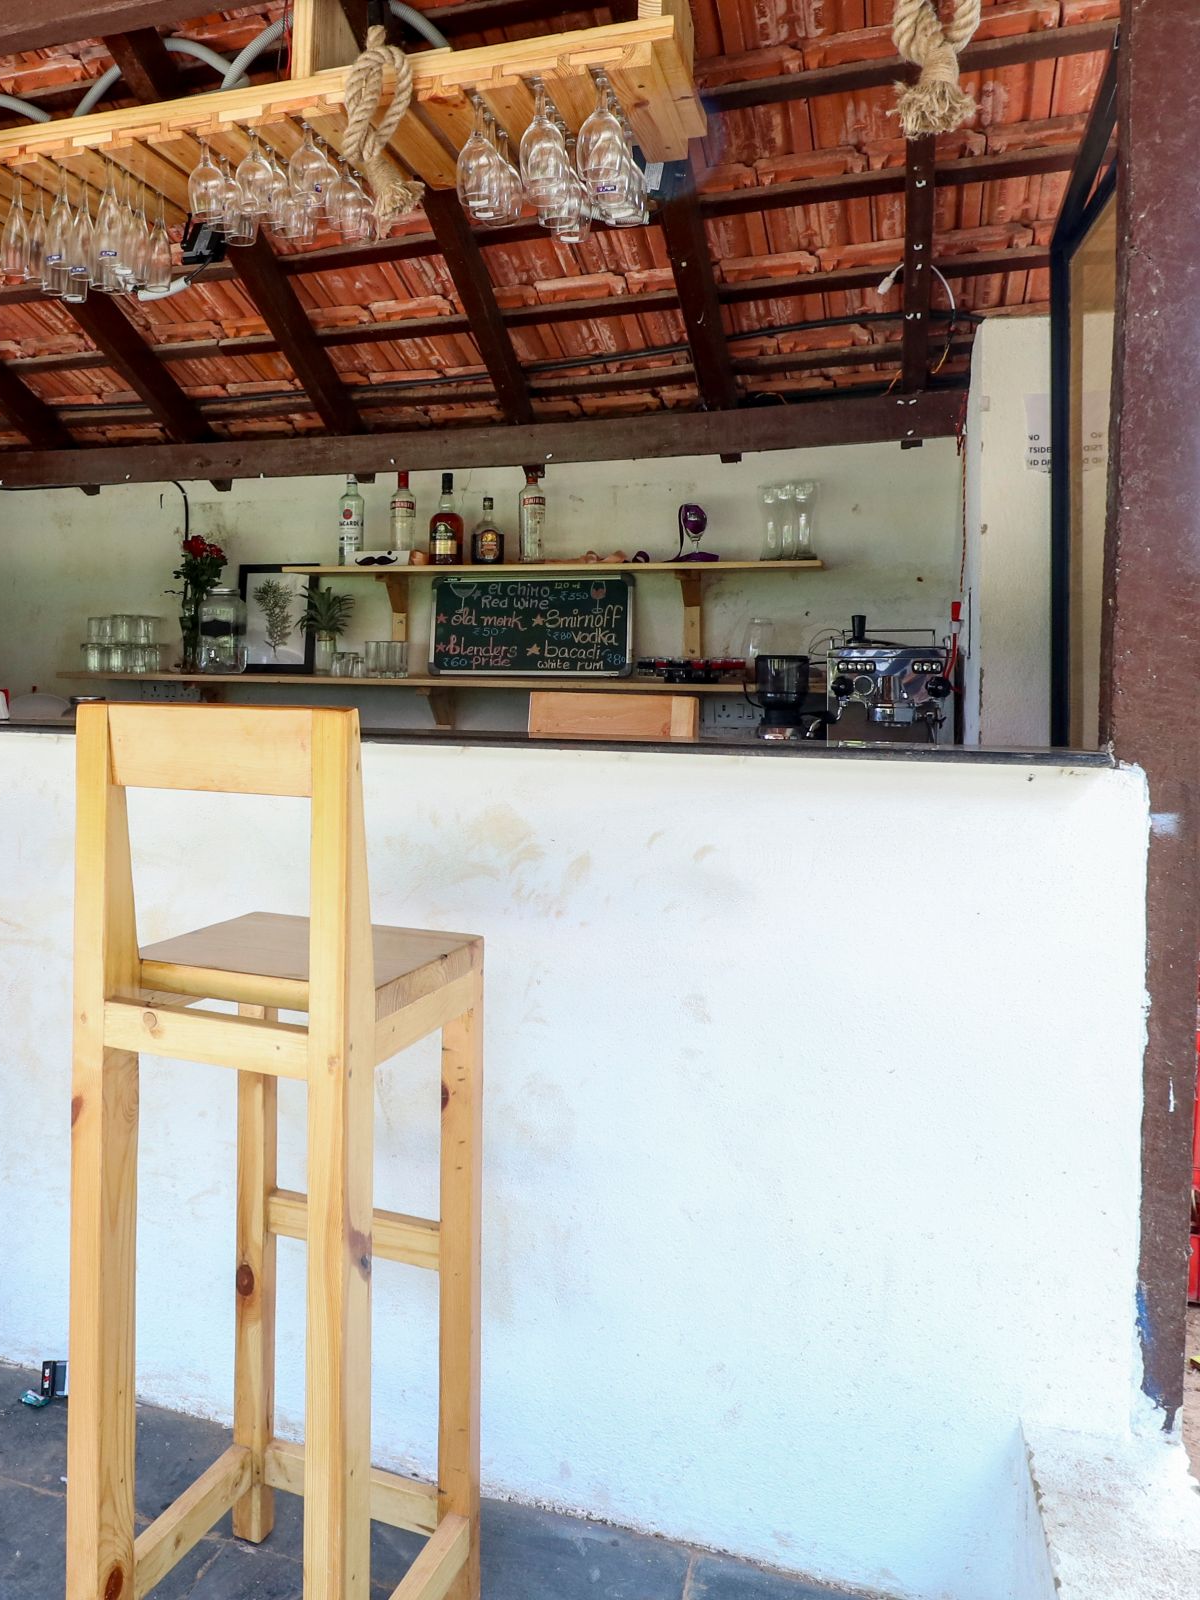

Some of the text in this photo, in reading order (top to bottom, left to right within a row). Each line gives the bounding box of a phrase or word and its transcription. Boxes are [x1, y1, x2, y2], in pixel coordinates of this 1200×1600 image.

[481, 595, 508, 609] Red
[480, 610, 527, 631] monk
[544, 604, 623, 628] Smirnoff
[445, 634, 518, 658] blenders
[471, 655, 511, 670] pride
[537, 659, 604, 671] white rum
